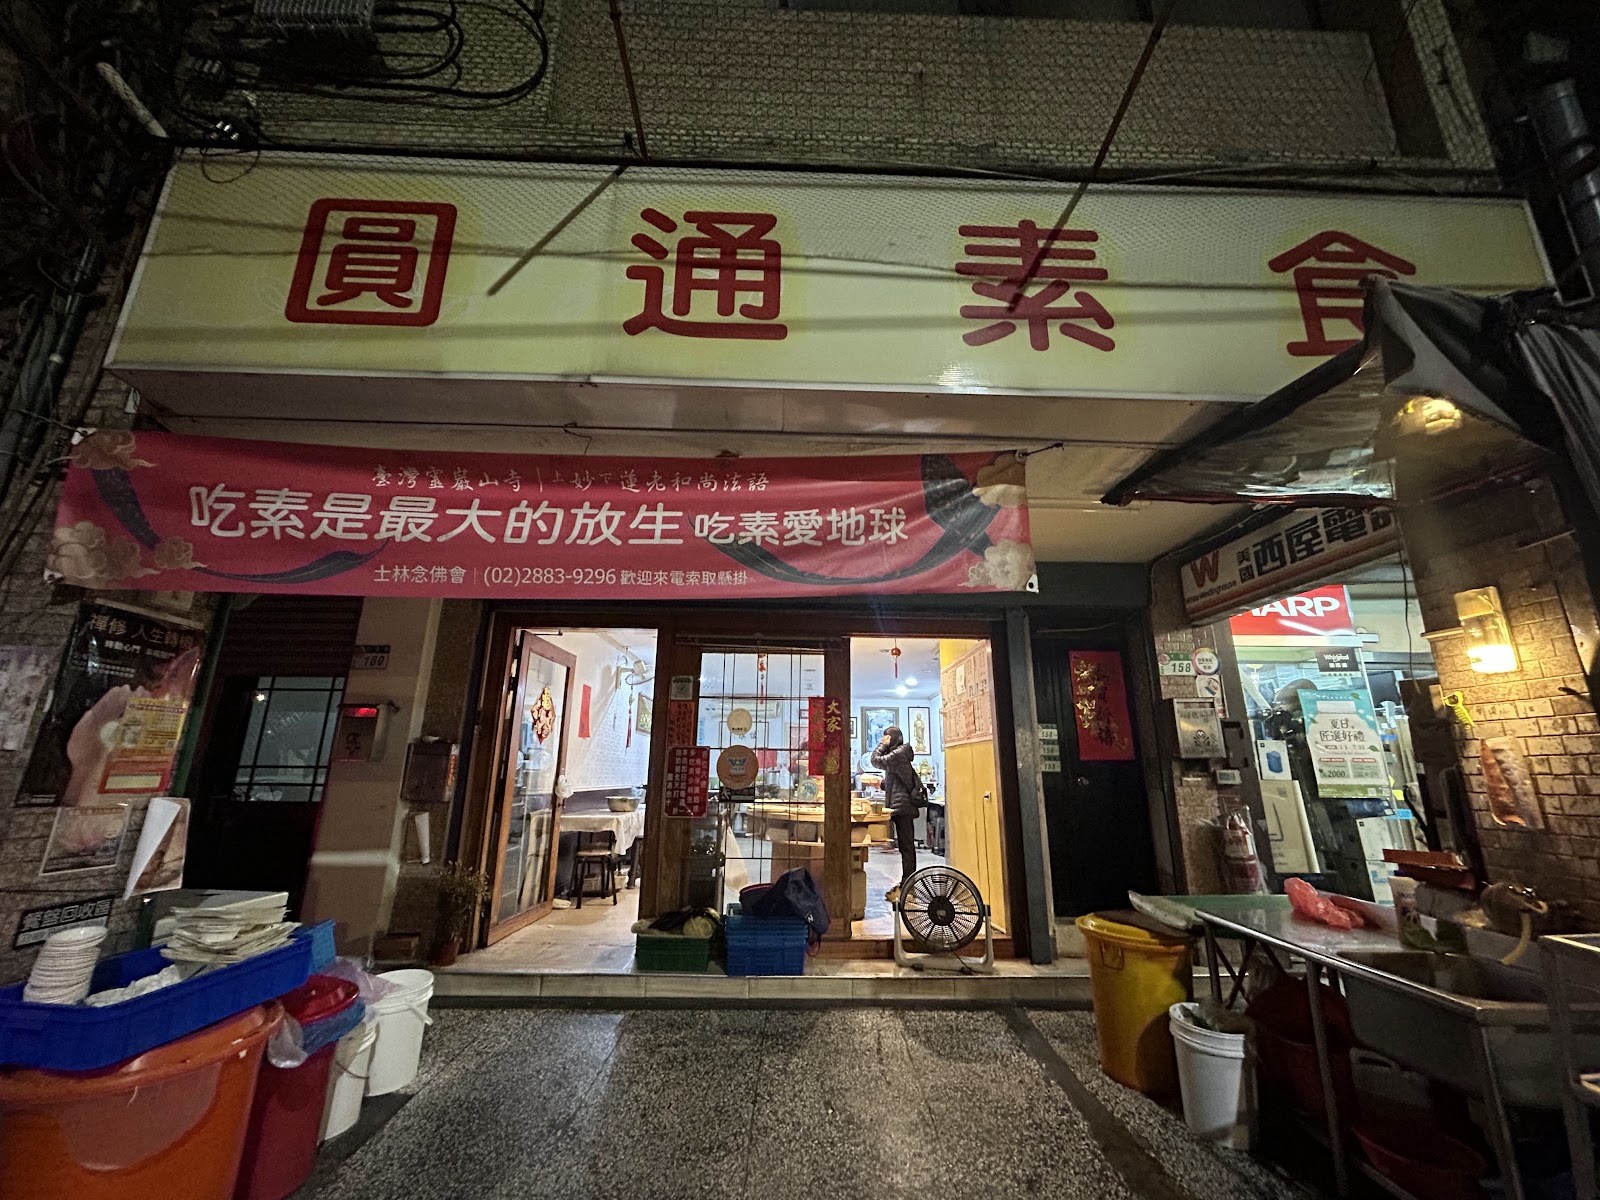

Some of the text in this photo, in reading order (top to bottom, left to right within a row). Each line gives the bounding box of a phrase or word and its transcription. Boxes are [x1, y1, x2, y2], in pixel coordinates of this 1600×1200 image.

[285, 197, 1416, 357] 圓通素食
[189, 482, 909, 548] 吃素是最大的放生 吃素愛地球
[374, 565, 748, 587] 士林念佛會 (02)2883-9296 歡迎來電索取懸掛
[1237, 596, 1341, 617] ARP
[364, 655, 385, 666] 160
[1171, 662, 1192, 673] 158
[1328, 770, 1346, 778] 2000
[22, 899, 112, 931] 餐盤回收區
